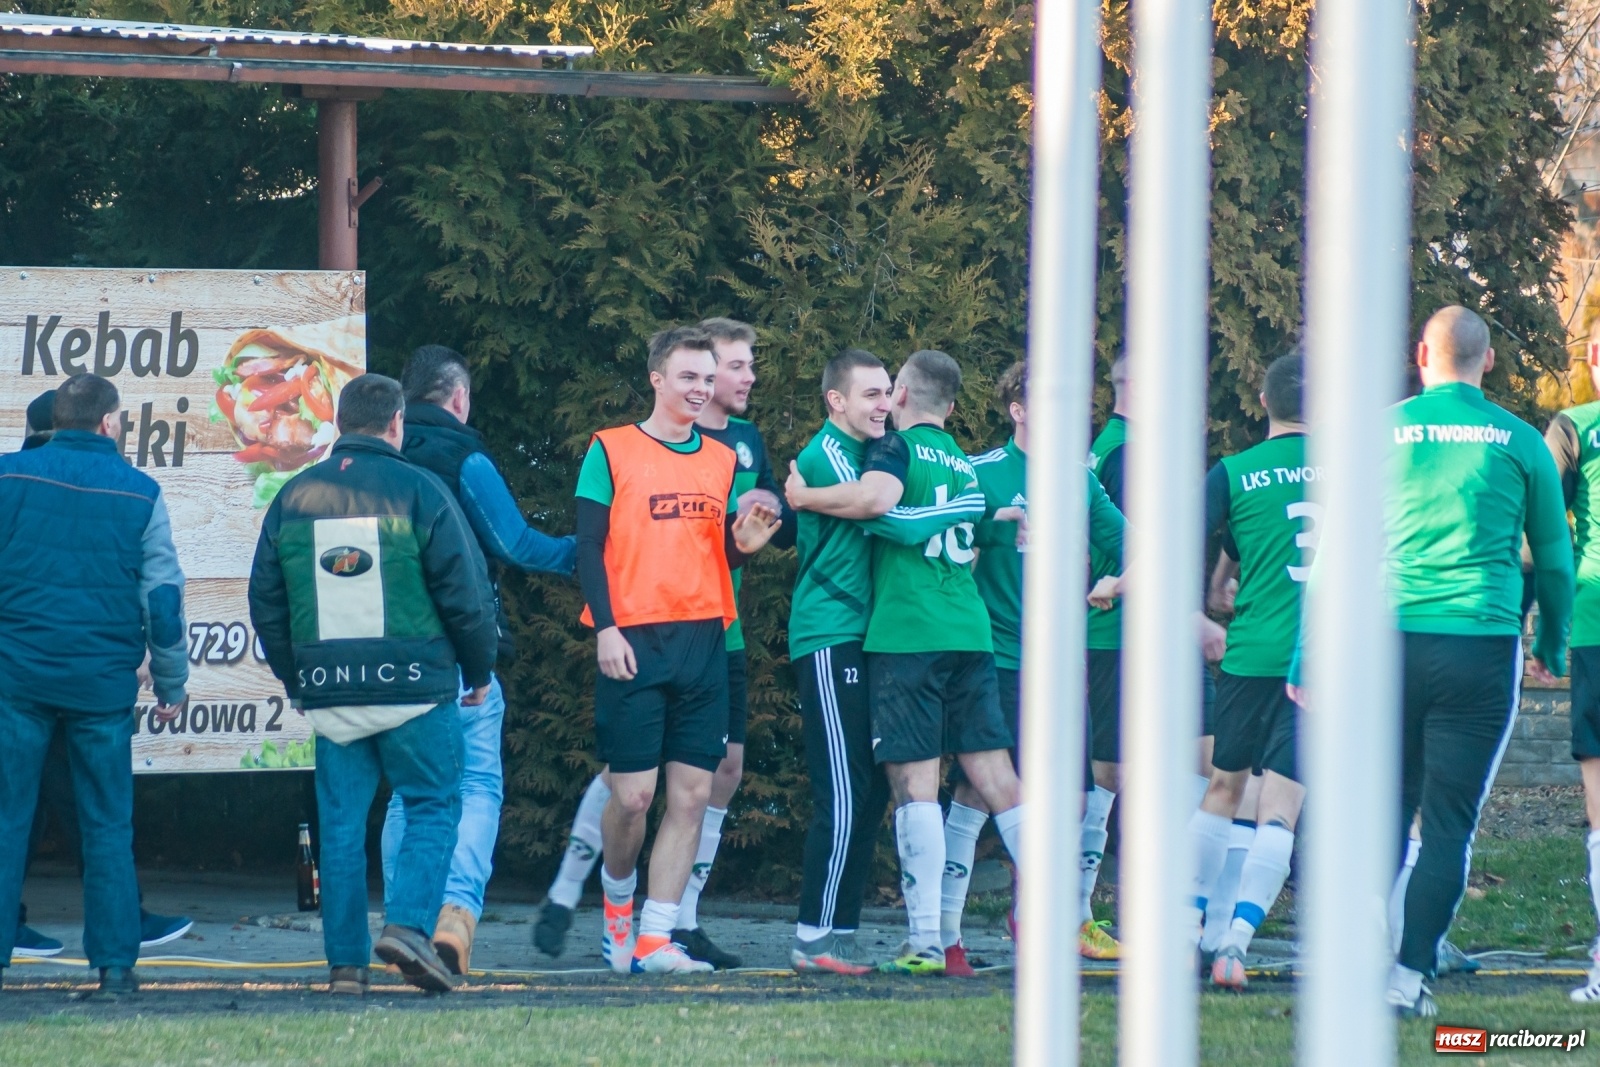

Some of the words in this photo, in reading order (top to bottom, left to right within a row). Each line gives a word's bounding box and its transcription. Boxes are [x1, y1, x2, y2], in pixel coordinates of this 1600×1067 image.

[21, 310, 200, 378] Kebab
[119, 396, 190, 468] tki
[1394, 424, 1424, 444] LKS
[1426, 423, 1513, 446] TWORKÓW
[915, 443, 938, 463] LKS
[1241, 469, 1271, 492] LKS
[1273, 466, 1327, 484] TWOR
[1286, 501, 1329, 582] 3
[189, 622, 249, 665] 729
[298, 662, 422, 688] SONICS
[844, 667, 859, 684] 22
[134, 694, 257, 735] rodowa
[265, 695, 284, 732] 2
